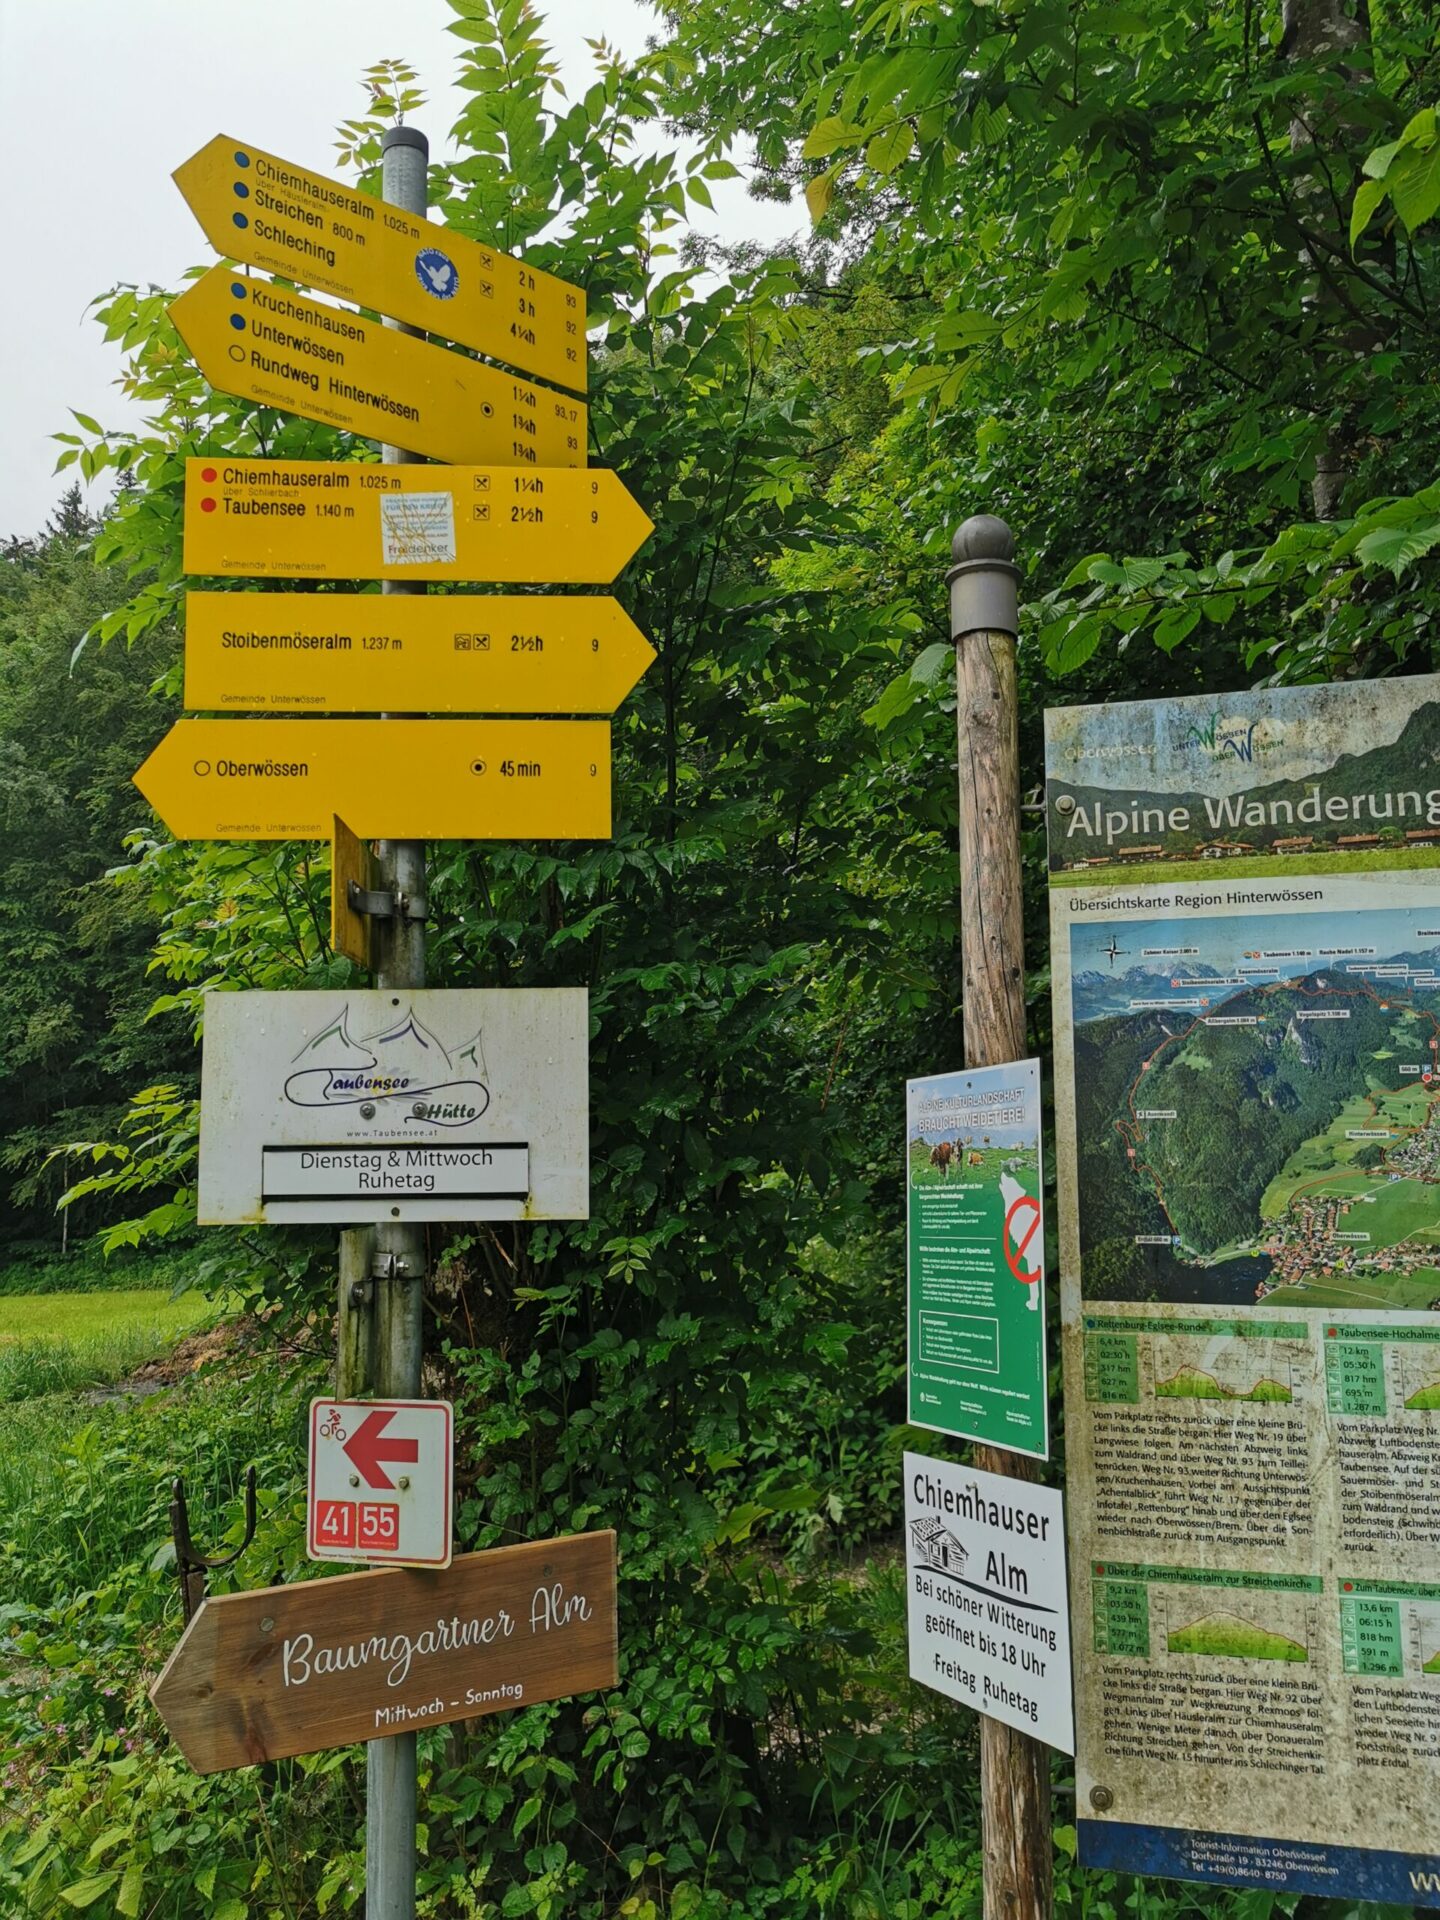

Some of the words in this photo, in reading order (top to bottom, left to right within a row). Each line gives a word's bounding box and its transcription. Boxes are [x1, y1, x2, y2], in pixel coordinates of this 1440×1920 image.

[256, 159, 374, 220] Chiemhauseralm
[384, 214, 408, 236] 1.025
[411, 228, 420, 240] m
[255, 190, 324, 230] Streichen
[332, 222, 353, 242] 800
[356, 232, 365, 246] m
[254, 219, 335, 268] Schleching
[254, 251, 298, 274] Gemeinde
[302, 268, 354, 296] Unterwössen
[519, 270, 526, 286] 2
[529, 274, 535, 291] h
[519, 298, 526, 314] 3
[529, 302, 535, 318] h
[566, 294, 576, 308] 93
[252, 288, 365, 344] Kruchenhausen
[566, 320, 576, 336] 92
[252, 319, 344, 366] Unterwössen
[566, 348, 576, 362] 92
[251, 350, 320, 392] Rundweg
[330, 376, 420, 422] Hinterwössen
[252, 384, 296, 407] Gemeinde
[300, 401, 353, 424] Unterwössen
[567, 436, 578, 450] 93
[223, 468, 350, 488] Chiemhauseralm
[360, 475, 388, 489] 1.025
[391, 479, 401, 489] m
[591, 481, 598, 494] 9
[223, 488, 243, 496] über
[248, 488, 300, 498] Schlierbach
[224, 498, 306, 516] Taubensee
[316, 504, 342, 518] 1.140
[344, 507, 354, 518] m
[591, 511, 598, 524] 9
[221, 560, 266, 570] Gemeinde
[271, 562, 326, 571] Unterwössen
[222, 632, 352, 650] Stoibenmöseralm
[362, 637, 389, 650] 1.237
[392, 640, 402, 650] m
[592, 639, 599, 652] 9
[221, 695, 266, 703] Gemeinde
[271, 695, 326, 704] Unterwössen
[216, 760, 308, 777] Oberwössen
[500, 761, 514, 777] 45
[518, 761, 541, 777] min
[590, 764, 597, 777] 9
[216, 824, 261, 833] Gemeinde
[266, 824, 321, 833] Unterwössen
[1066, 800, 1190, 845] Alpine
[1069, 896, 1170, 913] Übersichtskarte
[1175, 893, 1222, 910] Region
[1227, 888, 1323, 906] Hinterwössen
[322, 1069, 410, 1100] Taubensee
[426, 1104, 476, 1119] Hütte
[918, 1098, 944, 1114] ALPINE
[919, 1115, 962, 1133] BRAUCHT
[962, 1107, 1025, 1128] WEIDETIERE!
[346, 1129, 438, 1138] www.Taubensee.at
[300, 1151, 382, 1172] Dienstag
[387, 1151, 400, 1167] &
[406, 1148, 492, 1167] Mittwoch
[358, 1172, 435, 1191] Ruhetag
[1343, 1361, 1368, 1369] 05:30
[1093, 1411, 1112, 1419] Vom
[1114, 1412, 1153, 1423] Parkplatz
[1155, 1414, 1181, 1423] rechts
[1215, 1418, 1234, 1426] über
[1236, 1419, 1256, 1427] eine
[1258, 1419, 1284, 1429] kleine
[1287, 1421, 1306, 1430] Brü-
[1340, 1462, 1391, 1473] Taubensee.
[1394, 1465, 1410, 1474] Auf
[1412, 1466, 1428, 1475] der
[914, 1474, 1050, 1542] Chiemhauser
[322, 1505, 349, 1536] 41
[363, 1506, 395, 1537] 55
[985, 1551, 1028, 1594] Alm
[1108, 1564, 1129, 1576] Über
[1131, 1568, 1145, 1577] die
[1148, 1569, 1222, 1582] Chiemhauseralm
[1226, 1576, 1239, 1584] zur
[1242, 1576, 1312, 1590] Streichenkirche
[1356, 1584, 1372, 1592] Zum
[916, 1574, 933, 1598] Bei
[936, 1584, 984, 1616] schöner
[987, 1601, 1057, 1652] Witterung
[1360, 1604, 1377, 1613] 13,6
[1380, 1604, 1392, 1613] km
[1359, 1618, 1383, 1627] 06:15
[1387, 1619, 1392, 1628] h
[284, 1607, 514, 1686] Baumgartner
[530, 1583, 592, 1634] Alm
[1379, 1633, 1393, 1642] hm
[925, 1614, 976, 1648] geöffnet
[979, 1631, 997, 1657] bis
[1002, 1642, 1017, 1665] 18
[1021, 1650, 1046, 1678] Uhr
[1361, 1648, 1376, 1656] 591
[1102, 1666, 1122, 1675] Vom
[1124, 1667, 1164, 1680] Parkplatz
[1166, 1671, 1193, 1680] rechts
[1363, 1662, 1387, 1671] 1.296
[935, 1654, 976, 1694] Freitag
[984, 1676, 1038, 1722] Ruhetag
[1352, 1685, 1374, 1695] Vom
[1376, 1687, 1418, 1699] Parkplatz
[375, 1697, 444, 1728] Mittwoch
[466, 1684, 523, 1706] Sonntag
[1192, 1839, 1270, 1856] Tourist-Information
[1272, 1848, 1326, 1862] Oberwössen
[1192, 1851, 1235, 1864] Dorfstraße
[1238, 1856, 1248, 1865] 19
[1255, 1857, 1283, 1869] 83246
[1285, 1861, 1339, 1875] Oberwössen
[1192, 1863, 1205, 1872] Tel.
